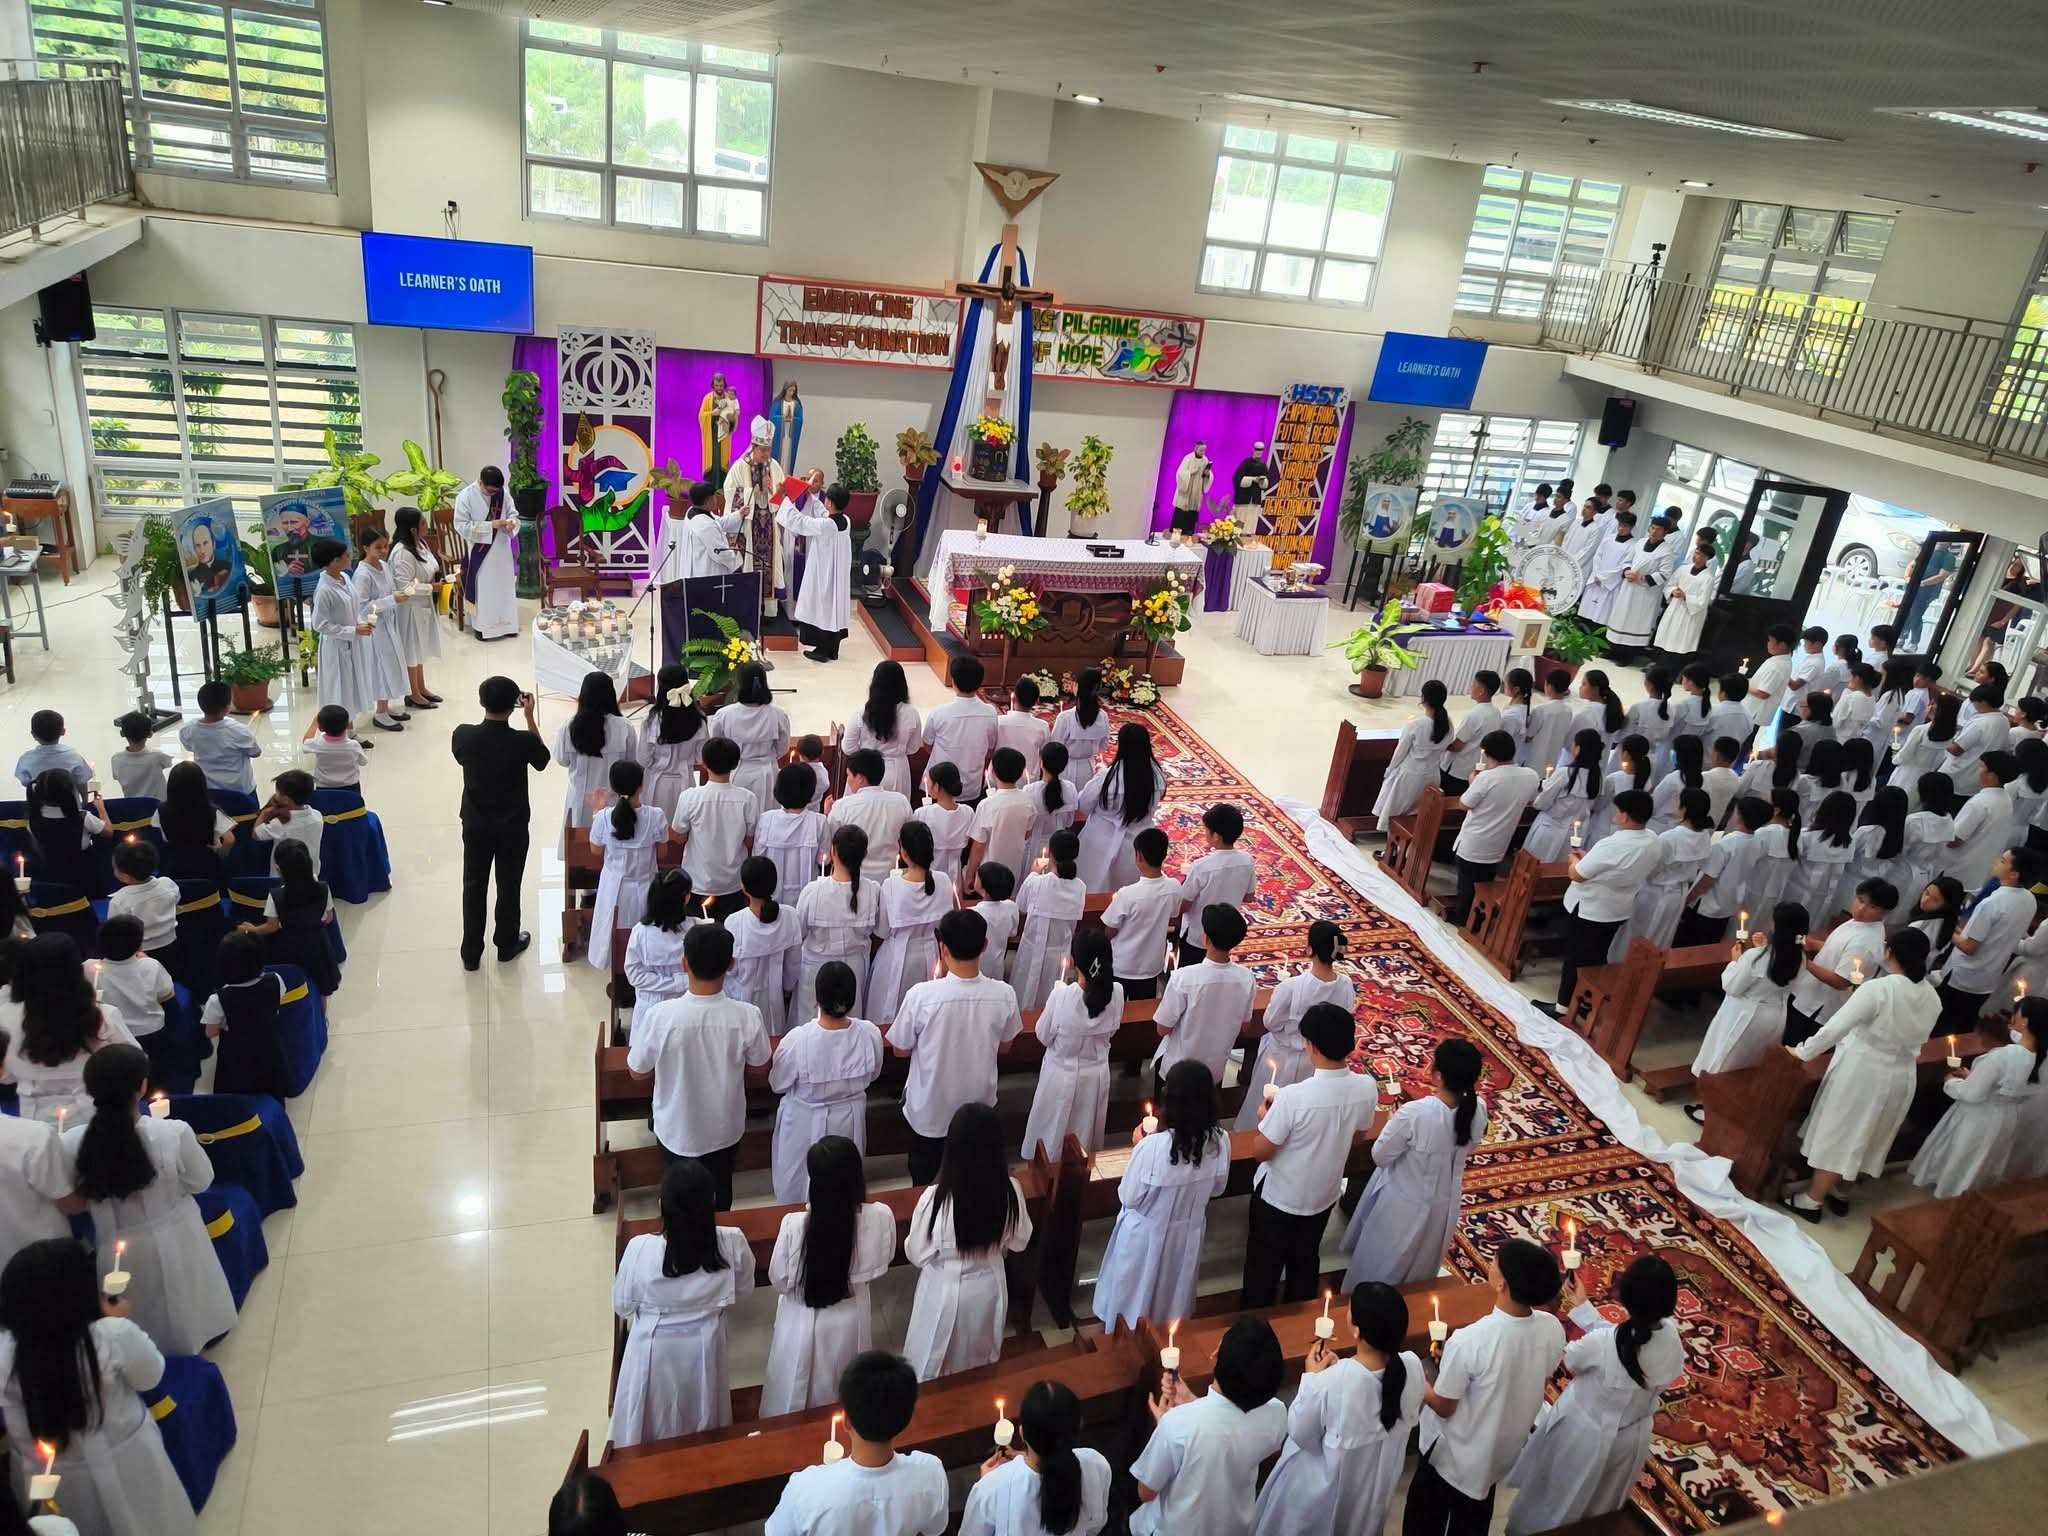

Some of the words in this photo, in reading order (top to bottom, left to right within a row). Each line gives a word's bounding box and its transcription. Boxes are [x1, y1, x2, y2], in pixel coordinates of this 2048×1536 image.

[399, 271, 466, 291] LEARNER'S
[469, 277, 501, 294] OATH
[804, 286, 914, 319] EMBRACING
[1061, 312, 1141, 338] PILGRIMS
[777, 319, 951, 356] TRANSFORMATION
[1058, 343, 1105, 366] HOPE
[1397, 361, 1440, 377] LEARNER'S
[1440, 366, 1462, 379] OATH
[1291, 384, 1345, 405] HSST
[1284, 403, 1336, 424] EMPOWERING
[1276, 422, 1312, 443] FUTURE
[1310, 424, 1340, 445] READY
[1282, 442, 1325, 461] LEARNERS
[1280, 461, 1319, 480] THROUGH
[1276, 479, 1314, 498] HOLISTIC
[1262, 497, 1318, 516] DEVELOPMENT
[1274, 516, 1299, 535] FAITH
